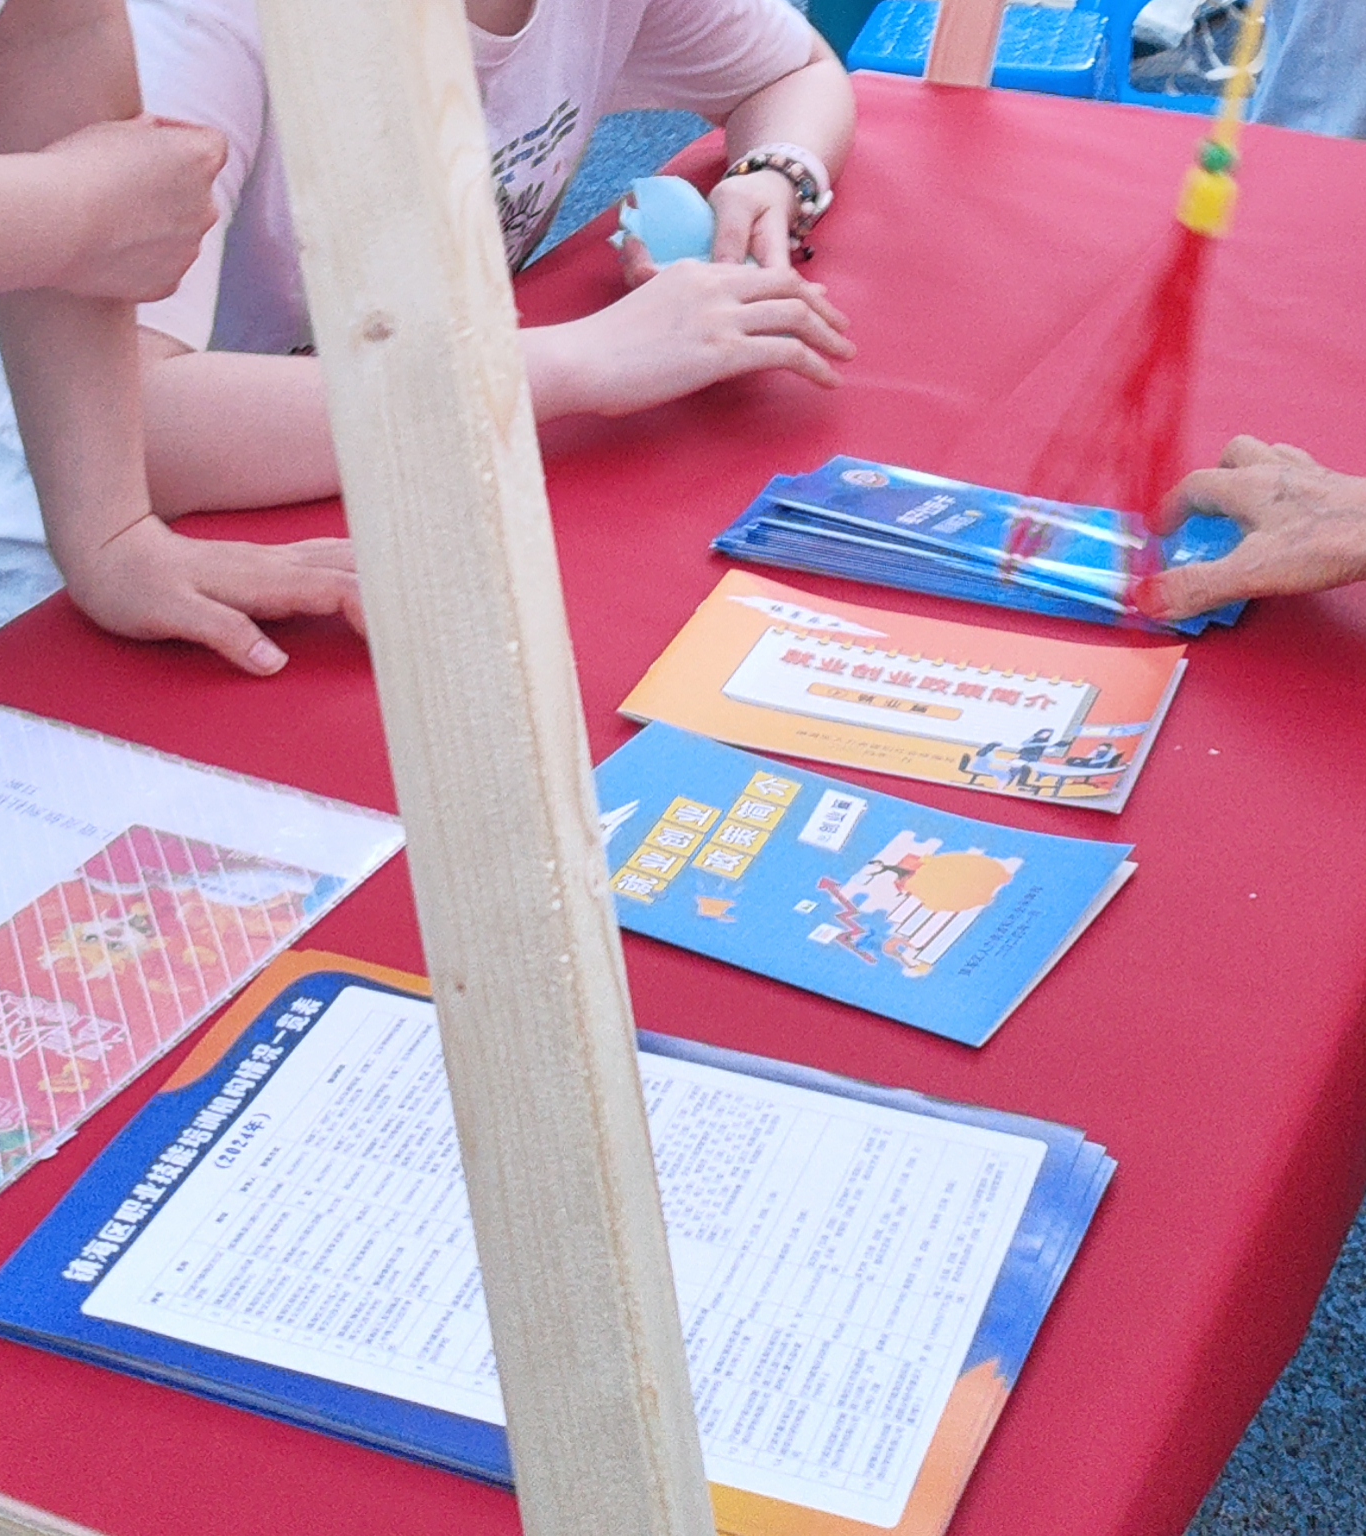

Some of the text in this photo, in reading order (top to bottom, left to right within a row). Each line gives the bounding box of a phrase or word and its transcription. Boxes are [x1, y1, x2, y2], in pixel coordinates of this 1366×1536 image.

[780, 648, 1058, 711] 就业创业政策简介
[615, 804, 714, 897] 就业创业
[703, 776, 791, 873] 政策简介
[61, 995, 325, 1283] 镇海区职业技能培训机构情况一览表
